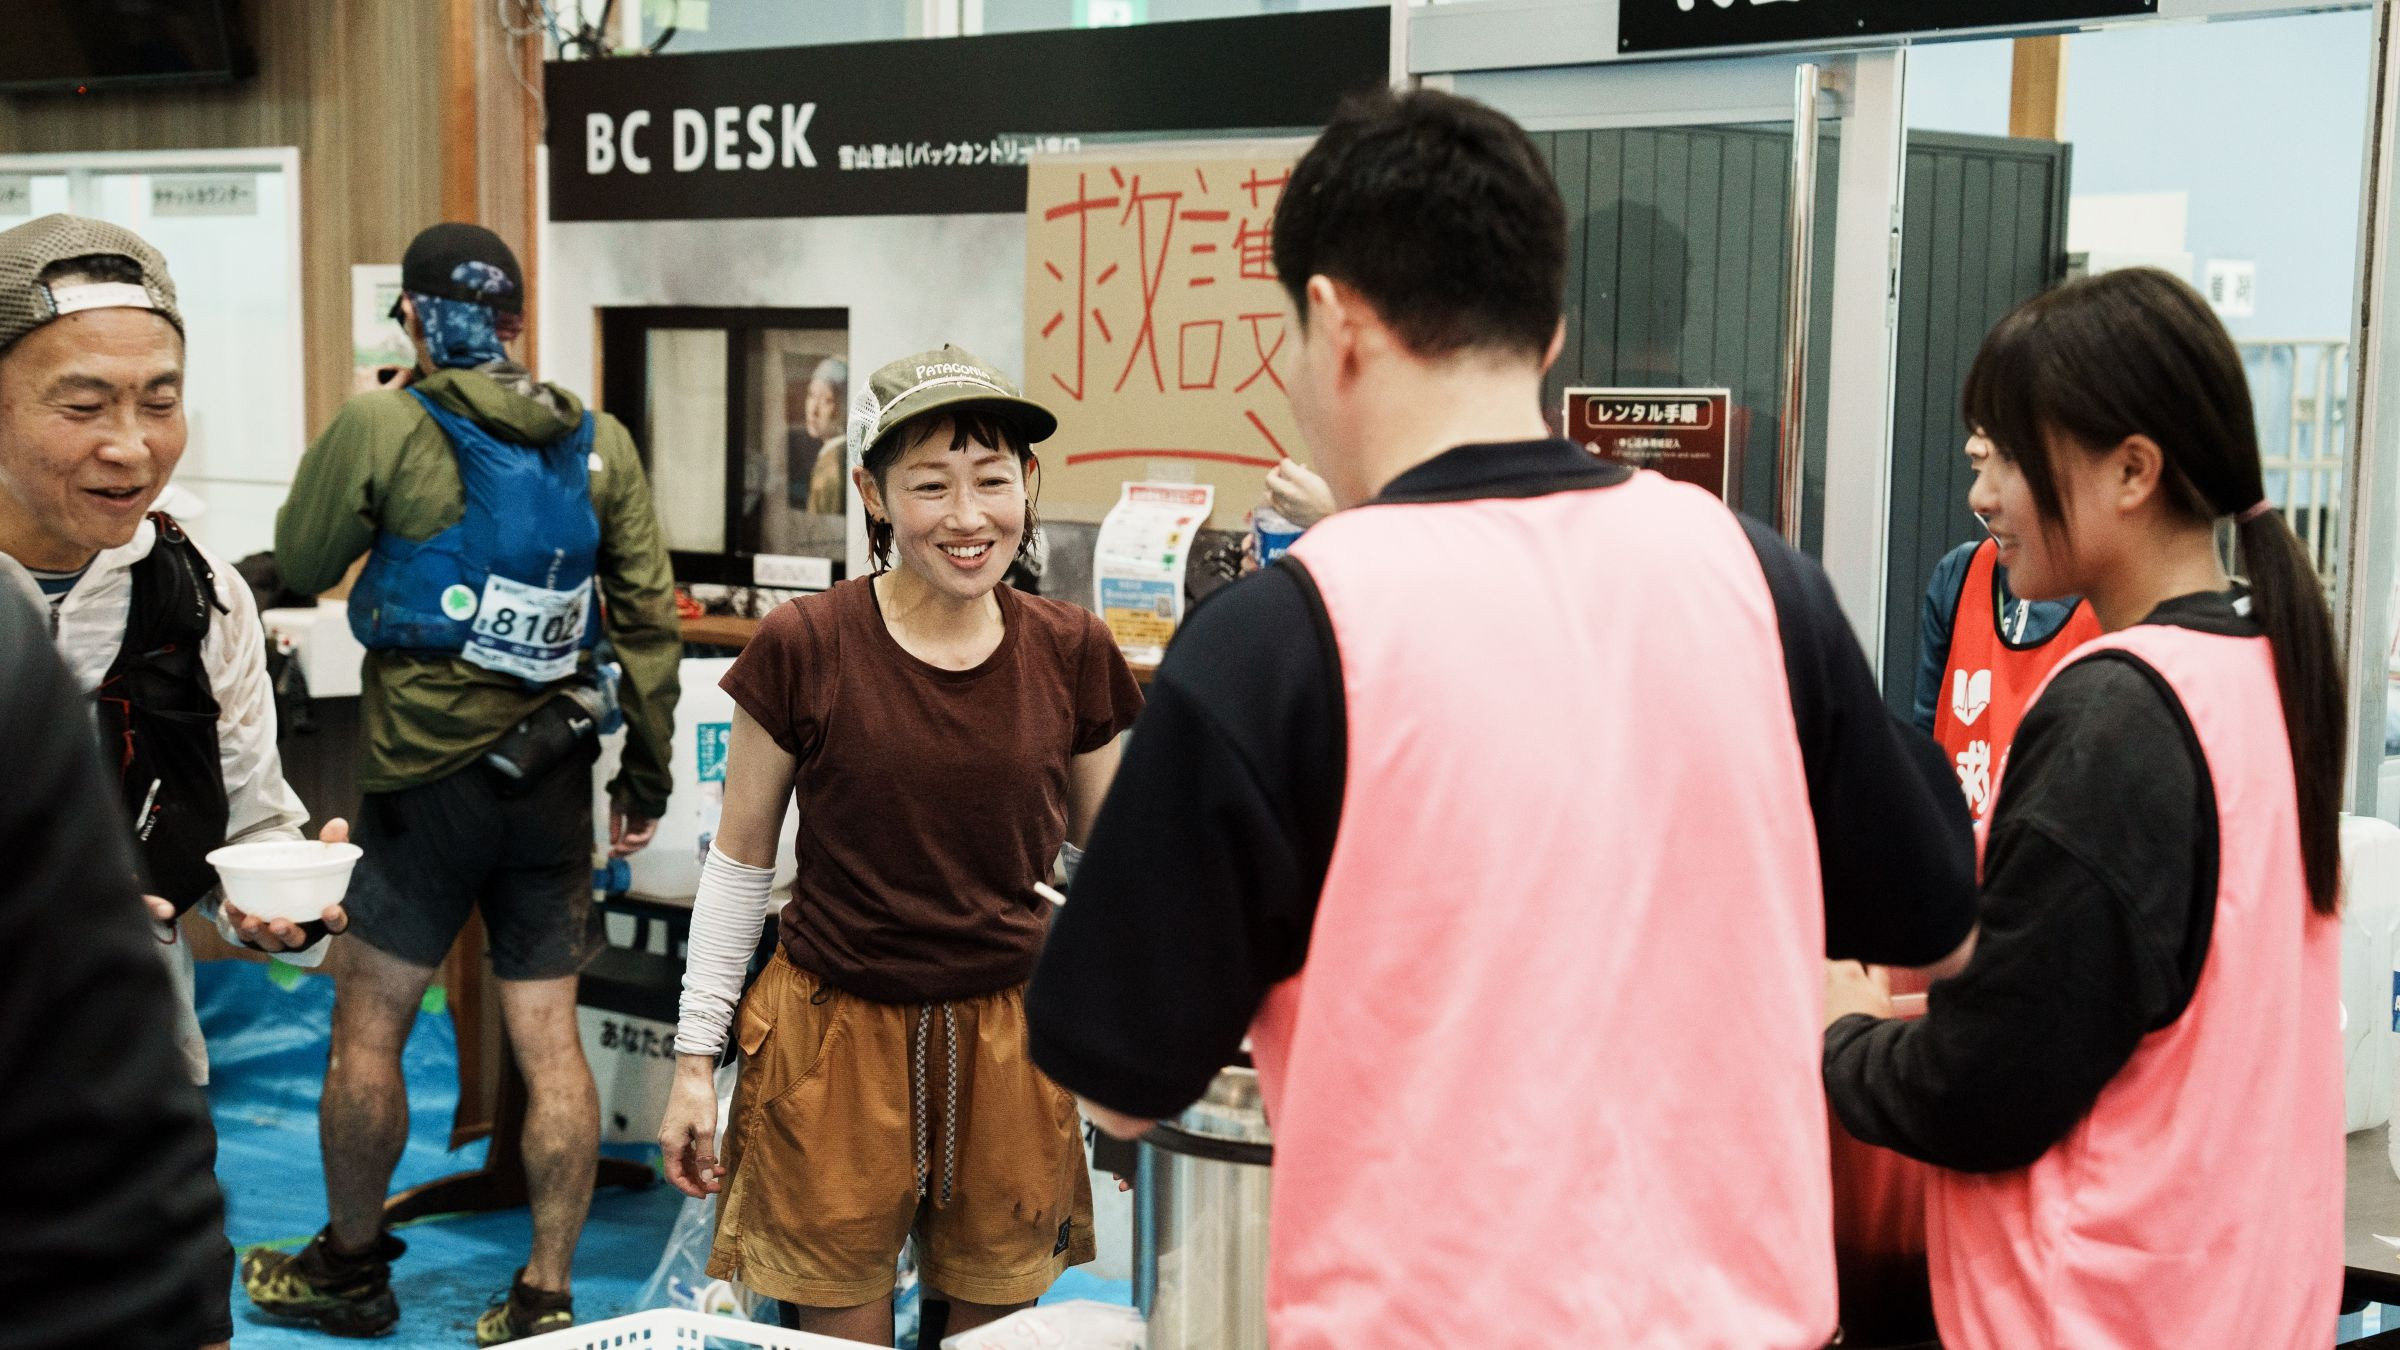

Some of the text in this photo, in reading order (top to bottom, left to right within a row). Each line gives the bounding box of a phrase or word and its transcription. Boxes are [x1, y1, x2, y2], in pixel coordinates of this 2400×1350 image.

[586, 102, 819, 174] BC DESK
[916, 363, 991, 380] PATAGONIA
[1597, 402, 1698, 424] レンタル手順
[491, 608, 580, 644] 8102
